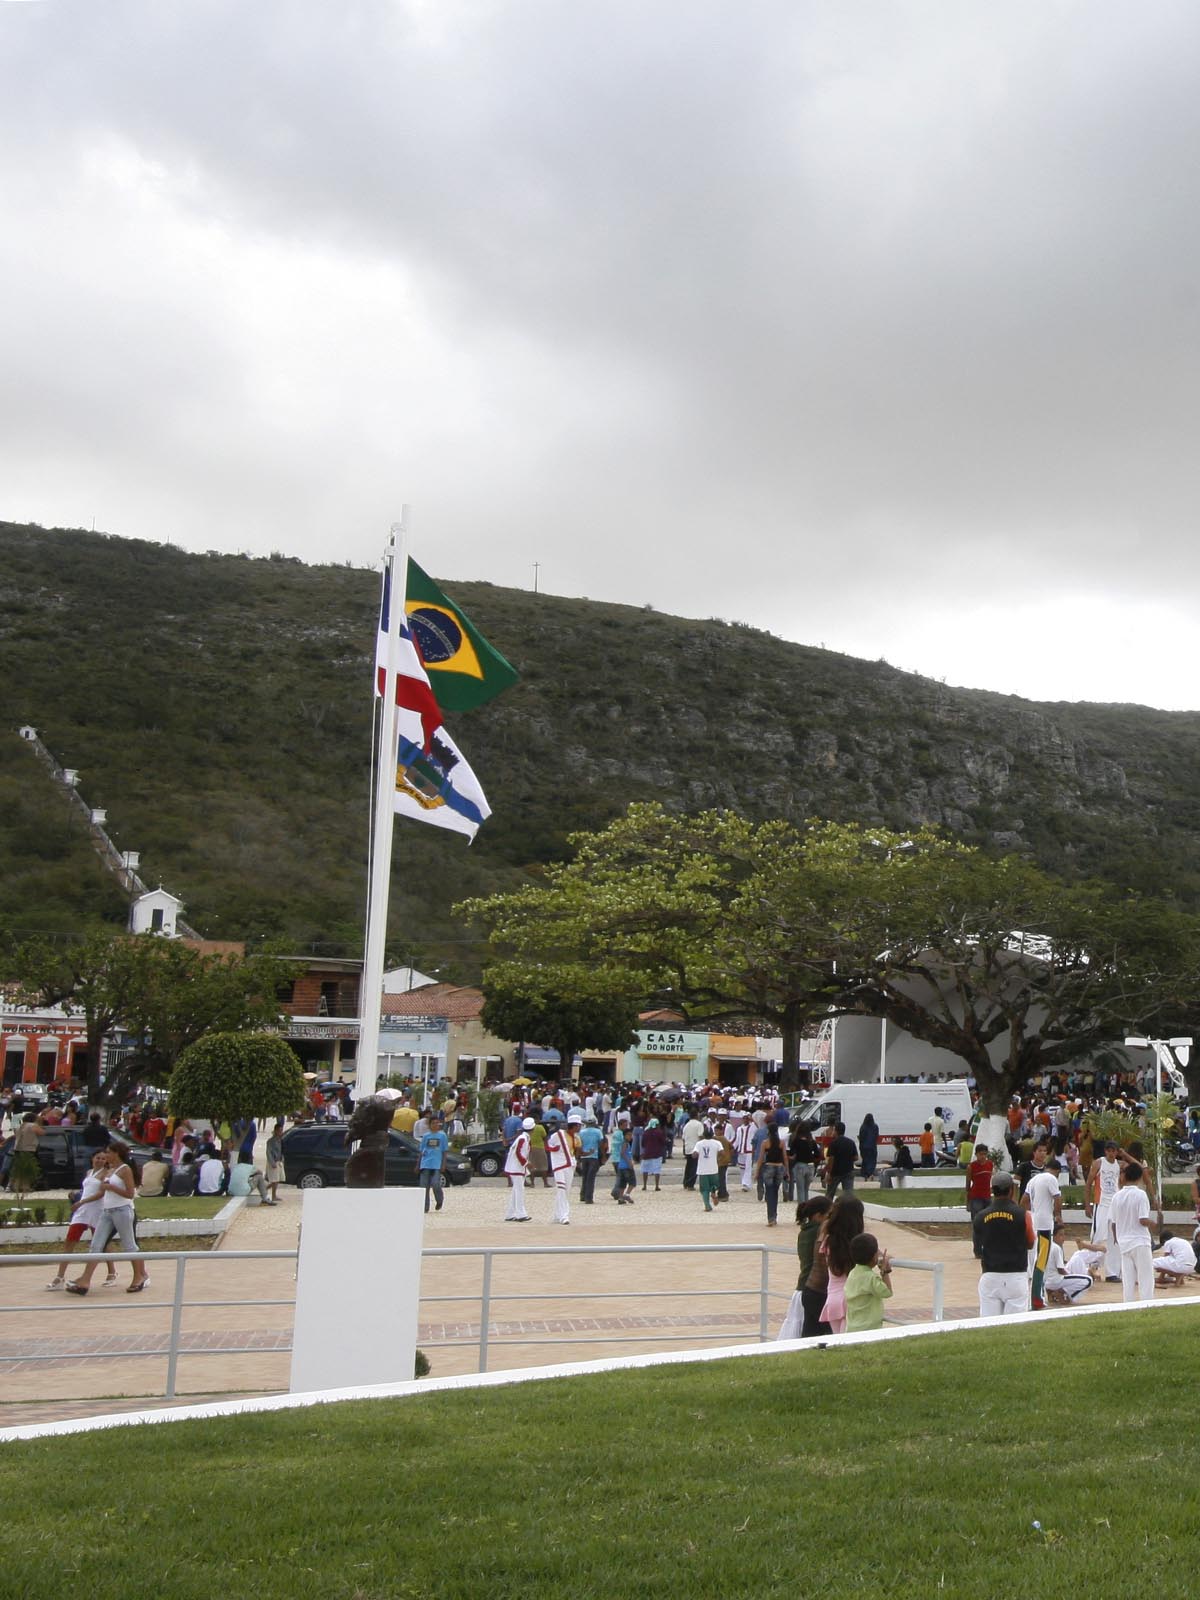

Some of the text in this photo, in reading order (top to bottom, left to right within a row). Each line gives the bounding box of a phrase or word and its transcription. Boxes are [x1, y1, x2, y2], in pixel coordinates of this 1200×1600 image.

[647, 1034, 685, 1043] CASA
[660, 1044, 685, 1052] NORTE
[984, 1211, 1014, 1223] SEGURANÇA
